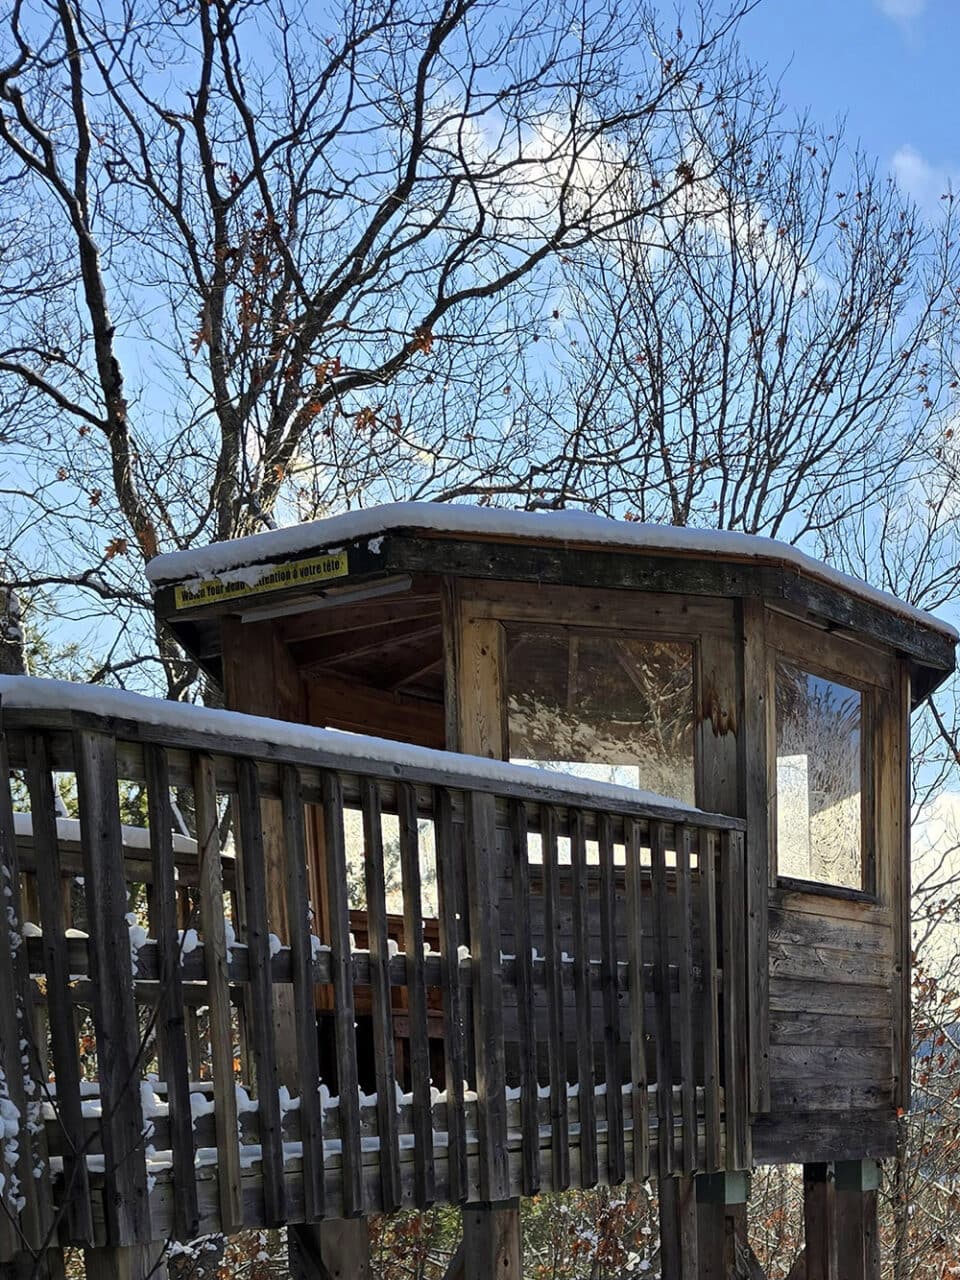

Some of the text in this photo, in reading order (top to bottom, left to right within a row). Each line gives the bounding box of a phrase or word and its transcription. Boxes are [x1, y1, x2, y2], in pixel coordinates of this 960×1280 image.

[206, 585, 224, 597] Your
[299, 563, 322, 577] votre
[323, 559, 340, 573] tête
